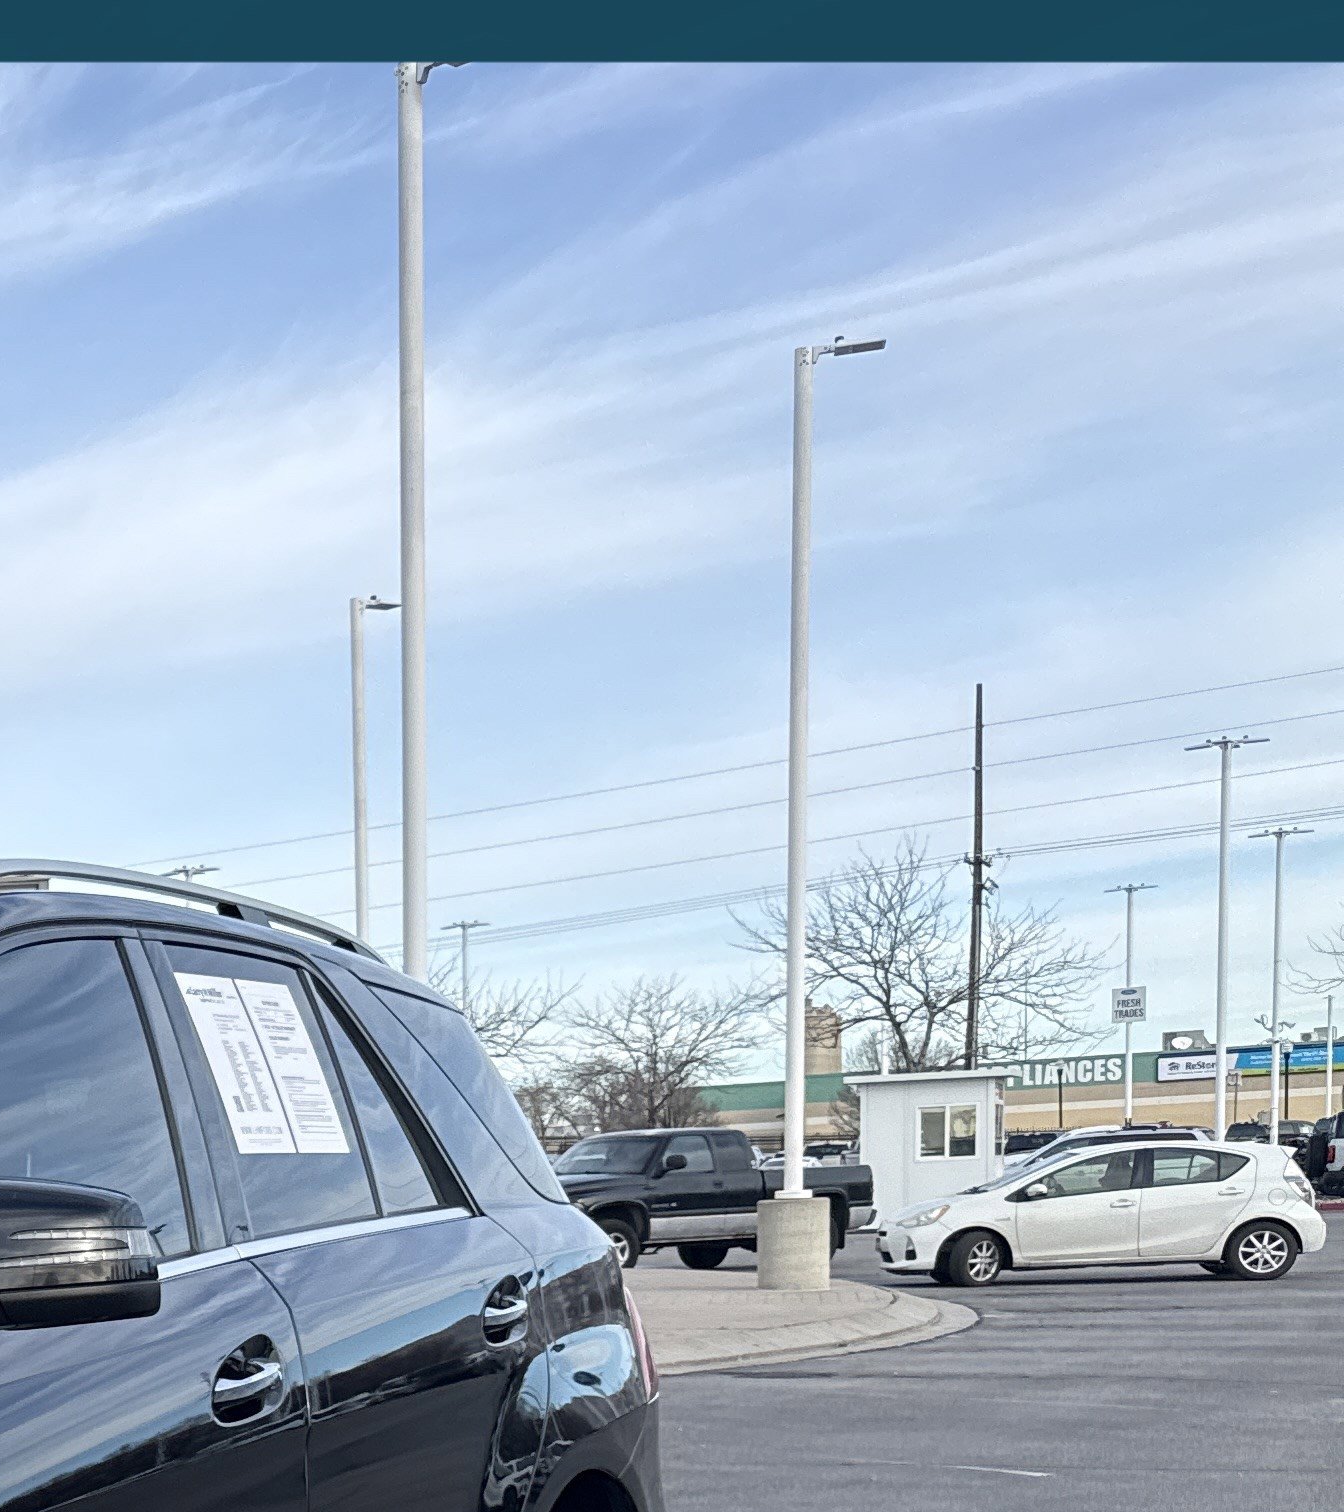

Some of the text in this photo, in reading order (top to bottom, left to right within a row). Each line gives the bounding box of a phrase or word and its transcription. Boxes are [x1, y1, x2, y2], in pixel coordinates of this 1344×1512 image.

[1116, 998, 1141, 1008] FRESH
[1114, 1008, 1144, 1019] TRADES
[1185, 1061, 1217, 1070] ReStor
[979, 1058, 1123, 1087] LIANCES
